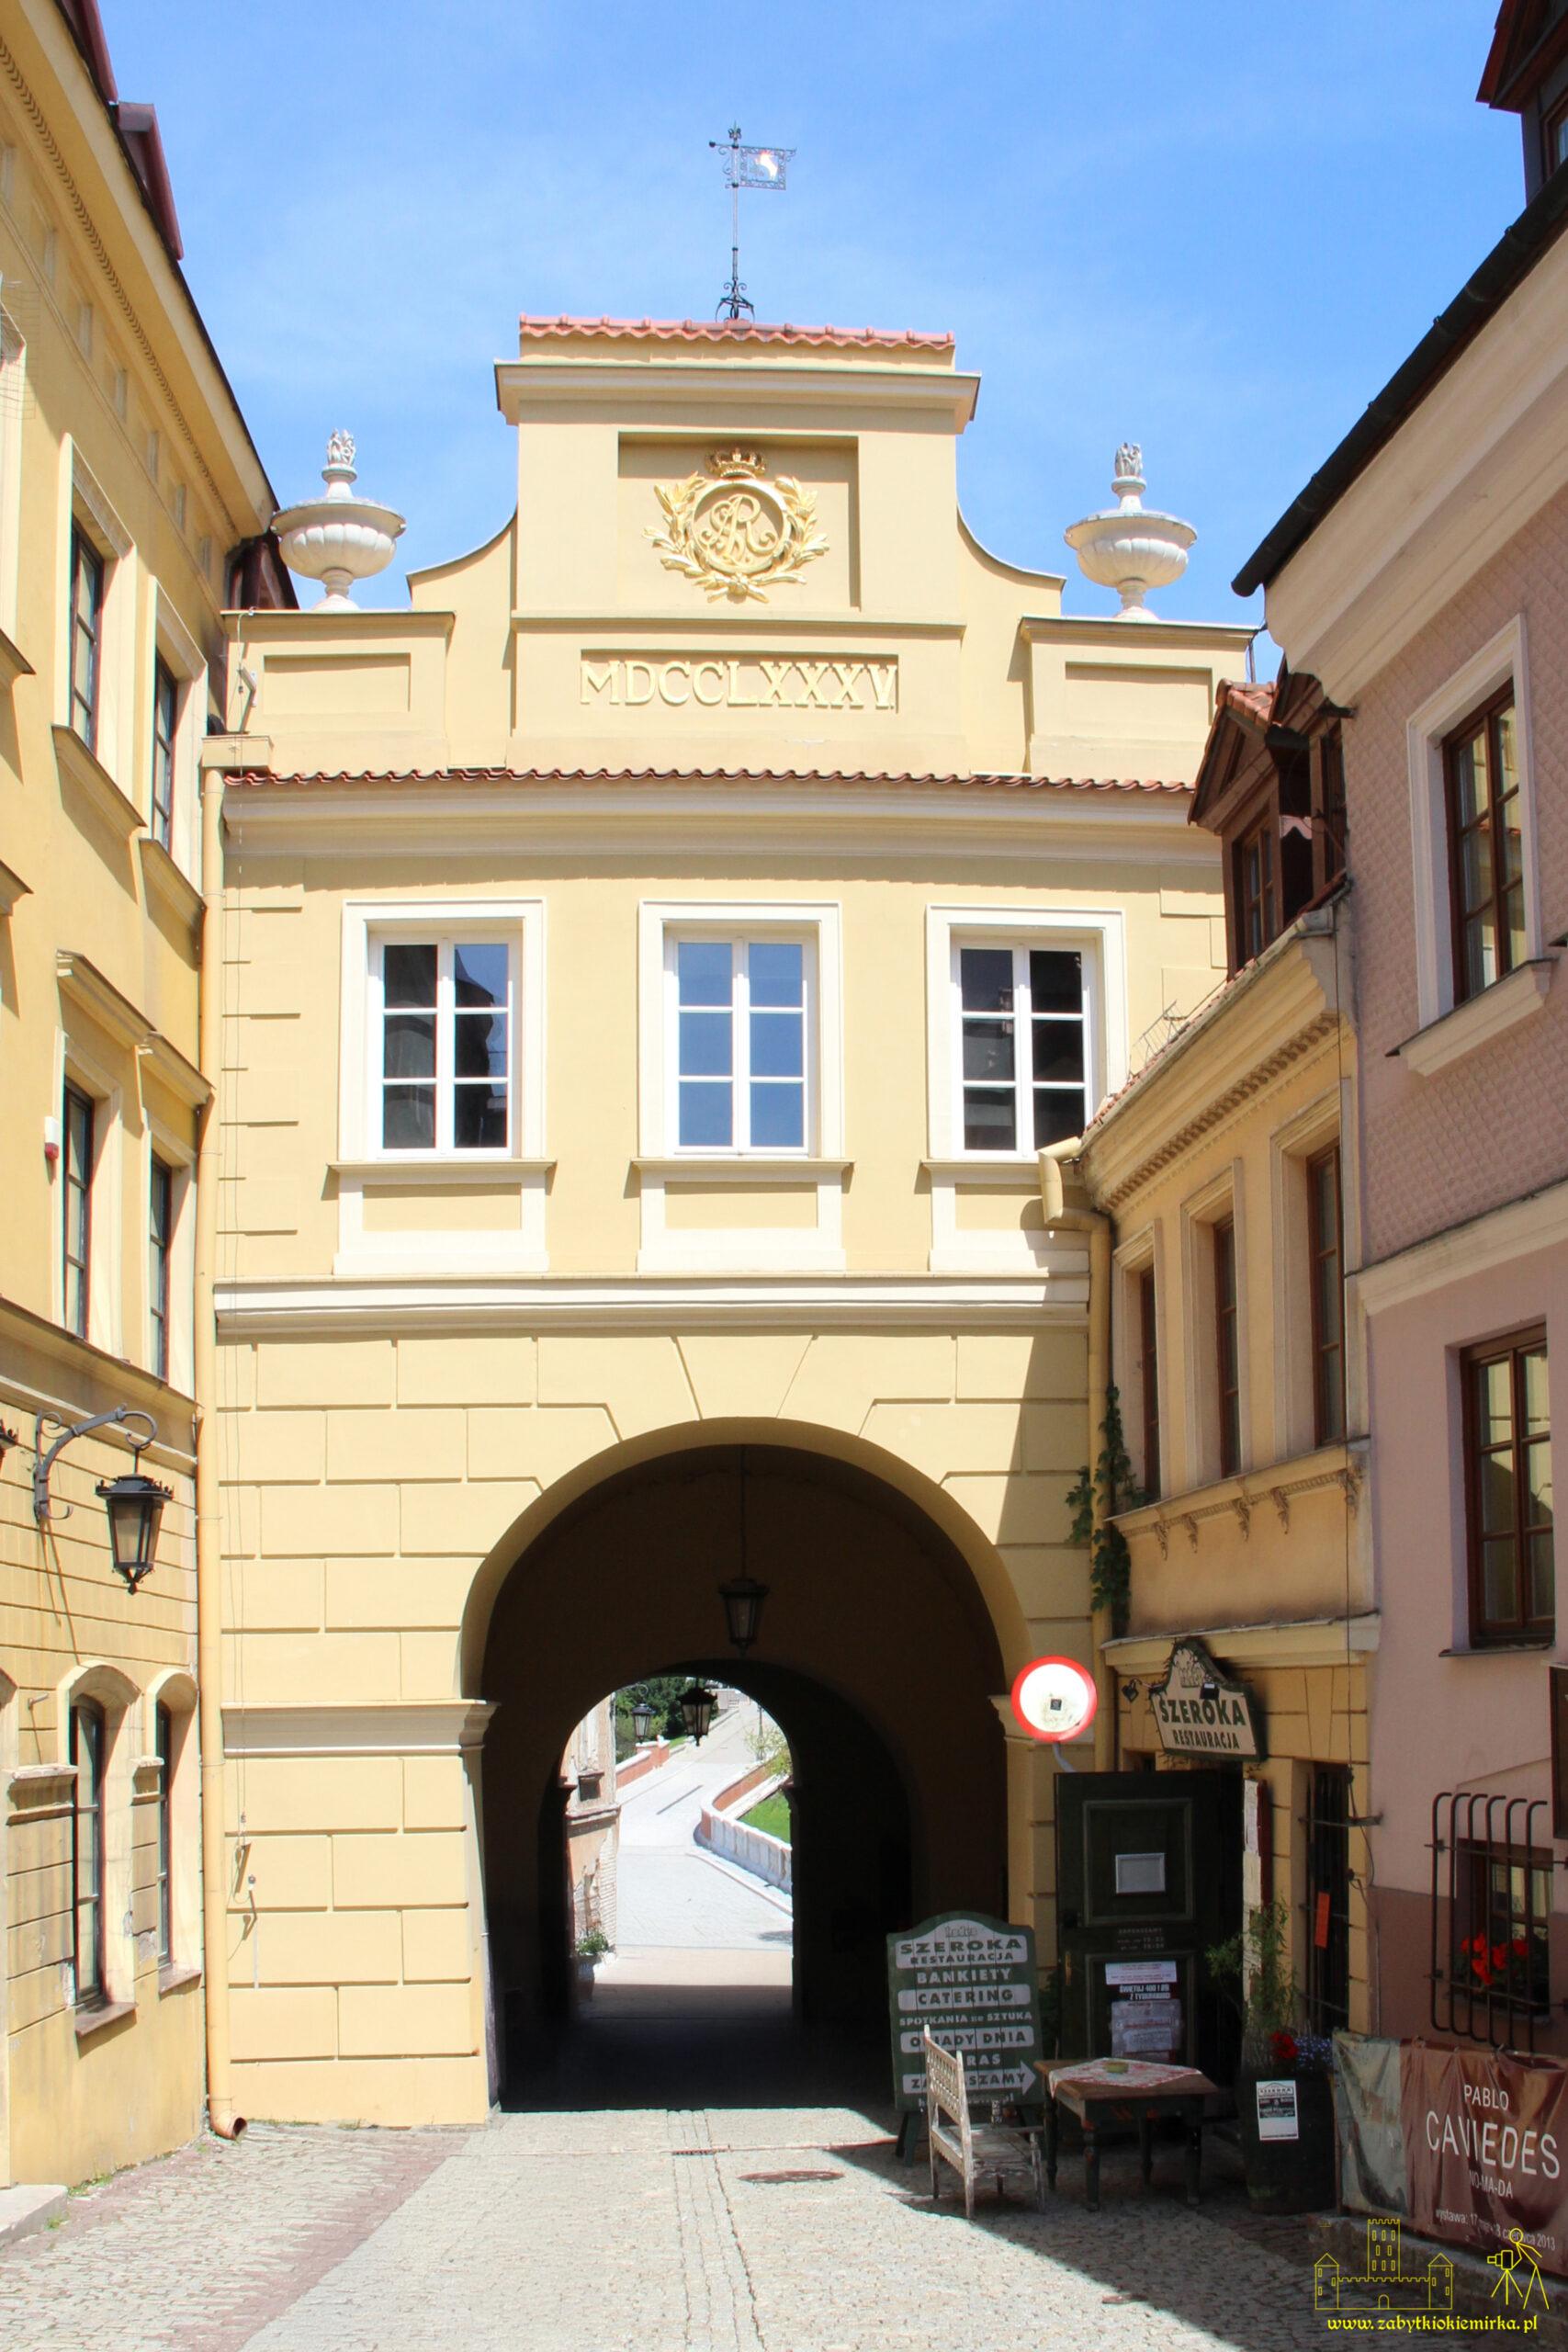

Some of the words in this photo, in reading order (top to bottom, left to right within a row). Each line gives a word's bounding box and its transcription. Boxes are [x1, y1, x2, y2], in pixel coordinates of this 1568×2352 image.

[1159, 1699, 1247, 1725] SZEROKA
[1172, 1729, 1240, 1749] RESTAURACJA
[900, 1939, 1021, 1954] SZEROKA
[910, 1952, 1013, 1964] RESTAURACJA
[917, 1968, 1011, 1984] BANKIETY
[919, 1989, 1013, 2005] CATERING
[910, 2034, 974, 2047] OIADY
[983, 2031, 1026, 2043] DNIA
[1464, 2085, 1509, 2111] PABLO
[1426, 2110, 1560, 2179] CAVIEDES
[1470, 2170, 1514, 2199] NO-MA-DA
[1537, 2233, 1556, 2251] 2013
